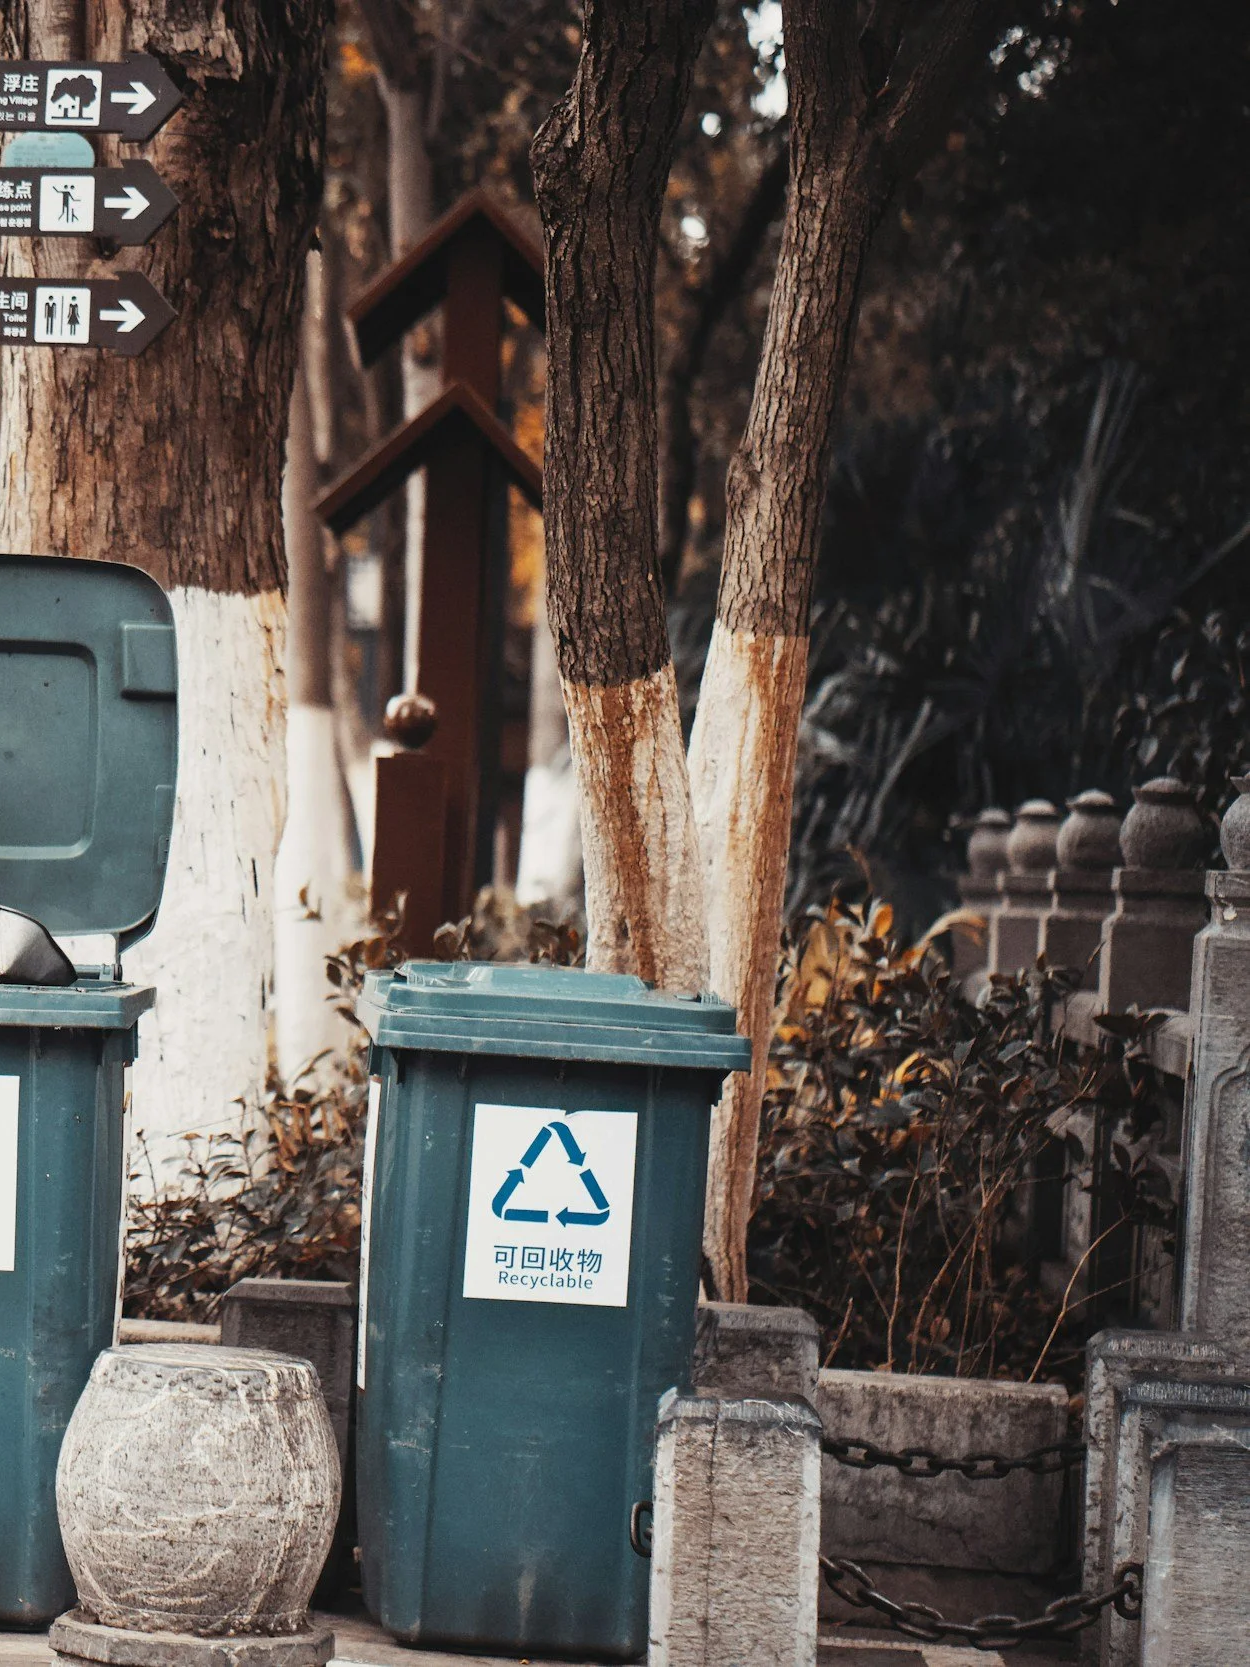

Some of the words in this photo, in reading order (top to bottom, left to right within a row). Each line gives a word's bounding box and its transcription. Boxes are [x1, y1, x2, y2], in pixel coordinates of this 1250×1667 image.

[3, 73, 39, 92] 浮庄
[9, 95, 39, 106] Village
[10, 203, 32, 213] point
[2, 312, 28, 323] Toilet
[494, 1245, 603, 1274] 可回收物
[499, 1271, 593, 1290] Recyclable
